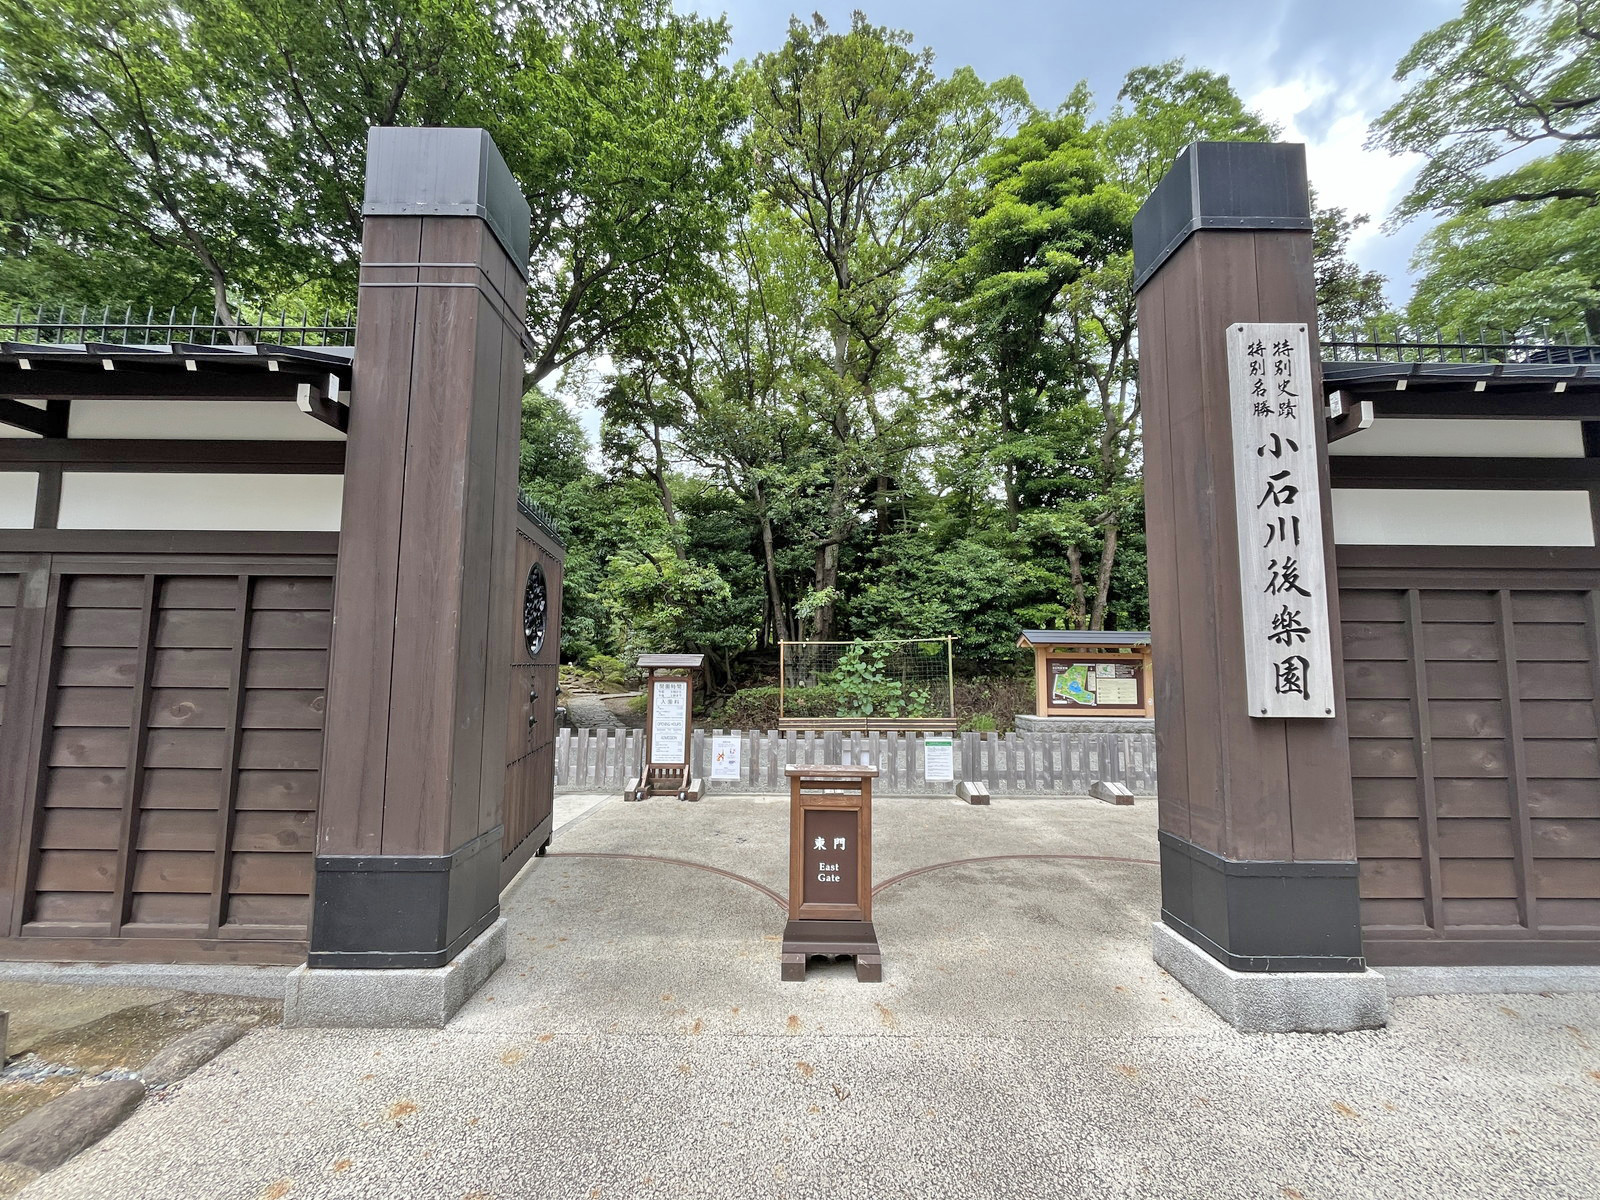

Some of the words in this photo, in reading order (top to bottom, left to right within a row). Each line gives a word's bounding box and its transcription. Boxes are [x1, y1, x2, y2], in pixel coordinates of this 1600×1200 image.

[1247, 338, 1275, 418] 特別名勝
[1272, 338, 1300, 420] 特別史蹟
[813, 836, 846, 851] 東門
[819, 862, 839, 871] East
[817, 873, 840, 882] Gate
